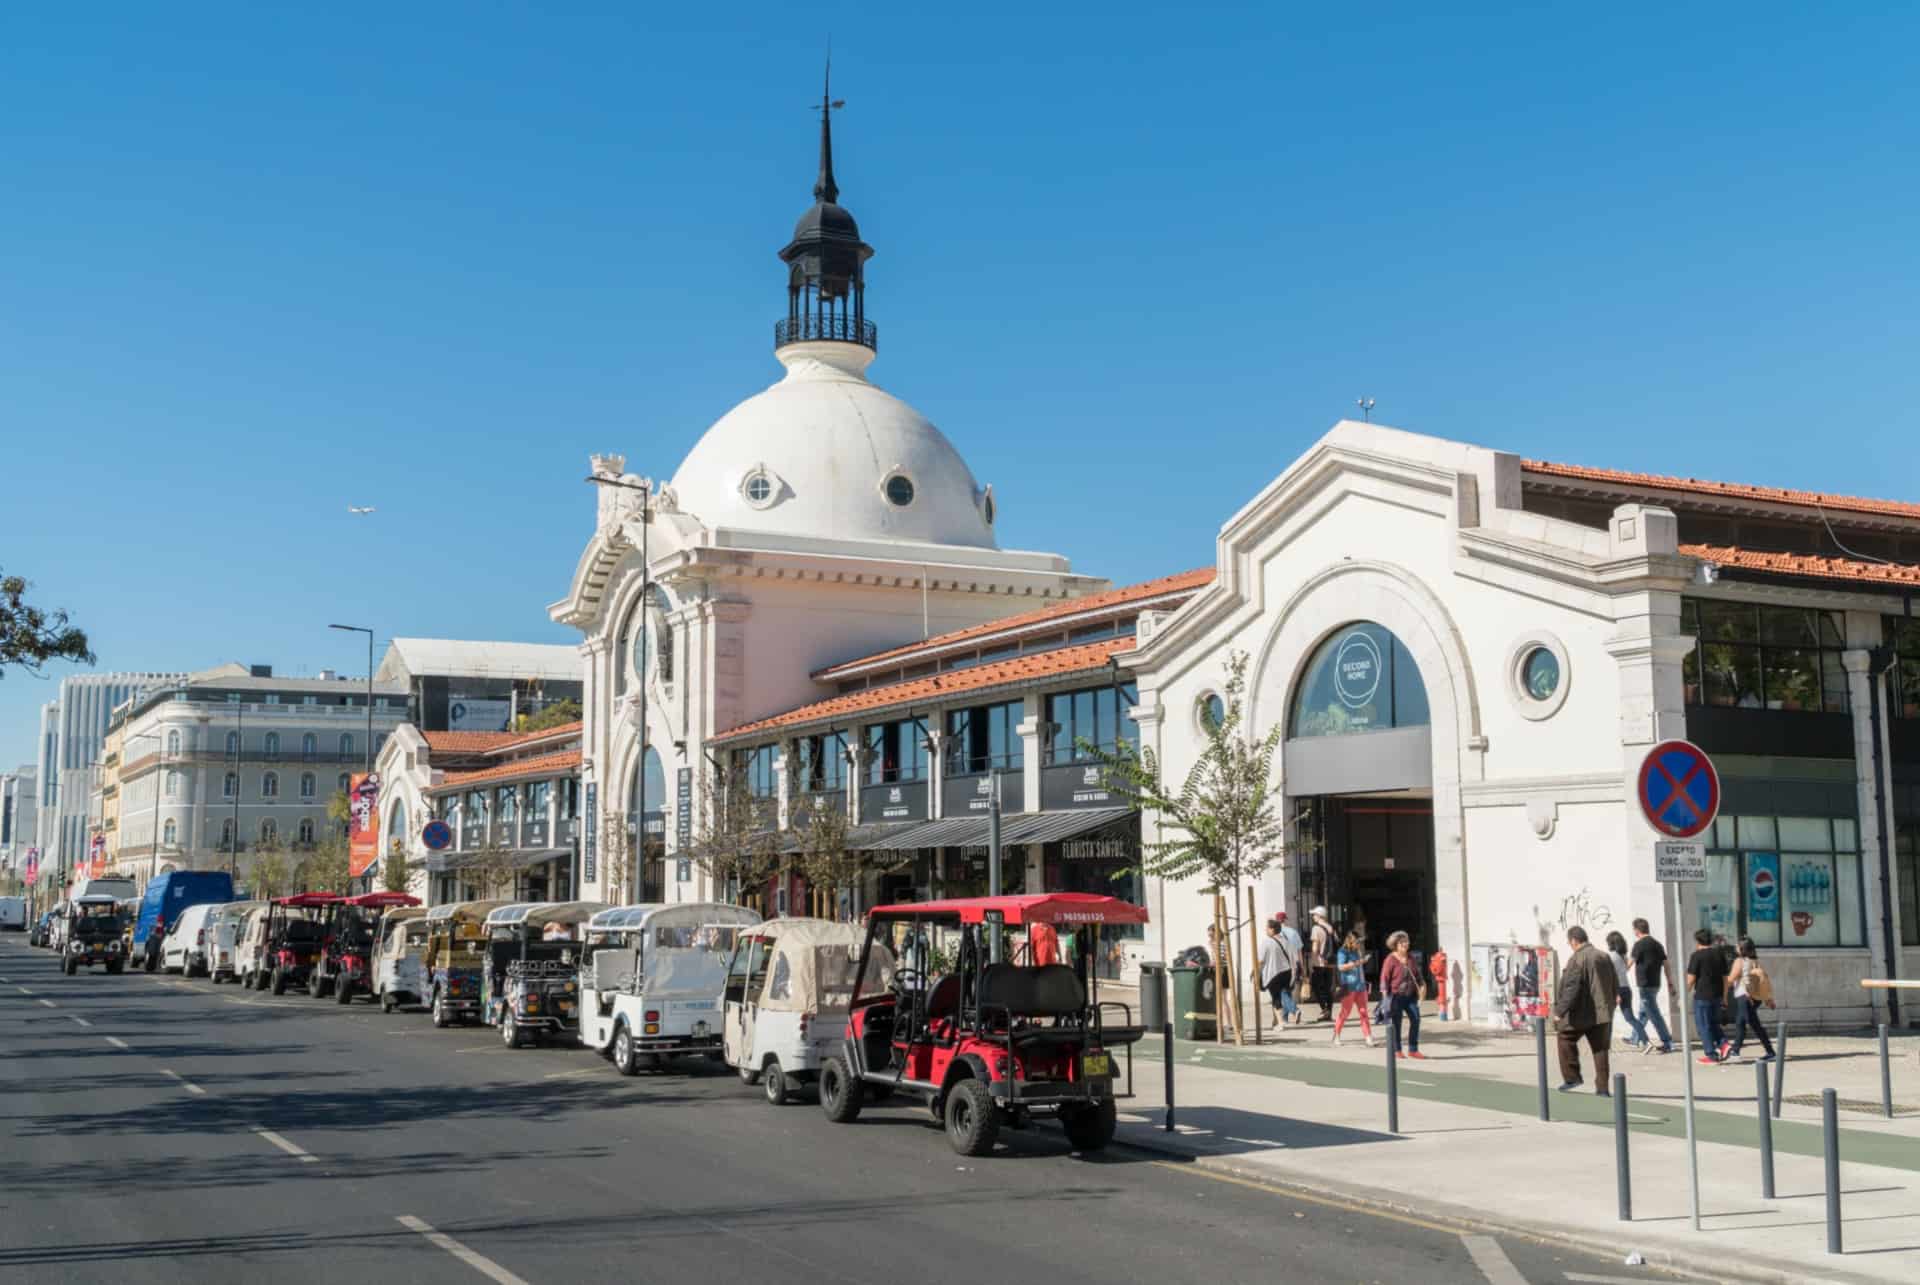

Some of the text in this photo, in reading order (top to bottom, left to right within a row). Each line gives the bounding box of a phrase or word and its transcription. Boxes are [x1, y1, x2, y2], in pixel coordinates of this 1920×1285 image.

[1343, 661, 1371, 672] SECOND
[1347, 672, 1366, 680] HOME
[1659, 857, 1702, 866] CIRCTOS
